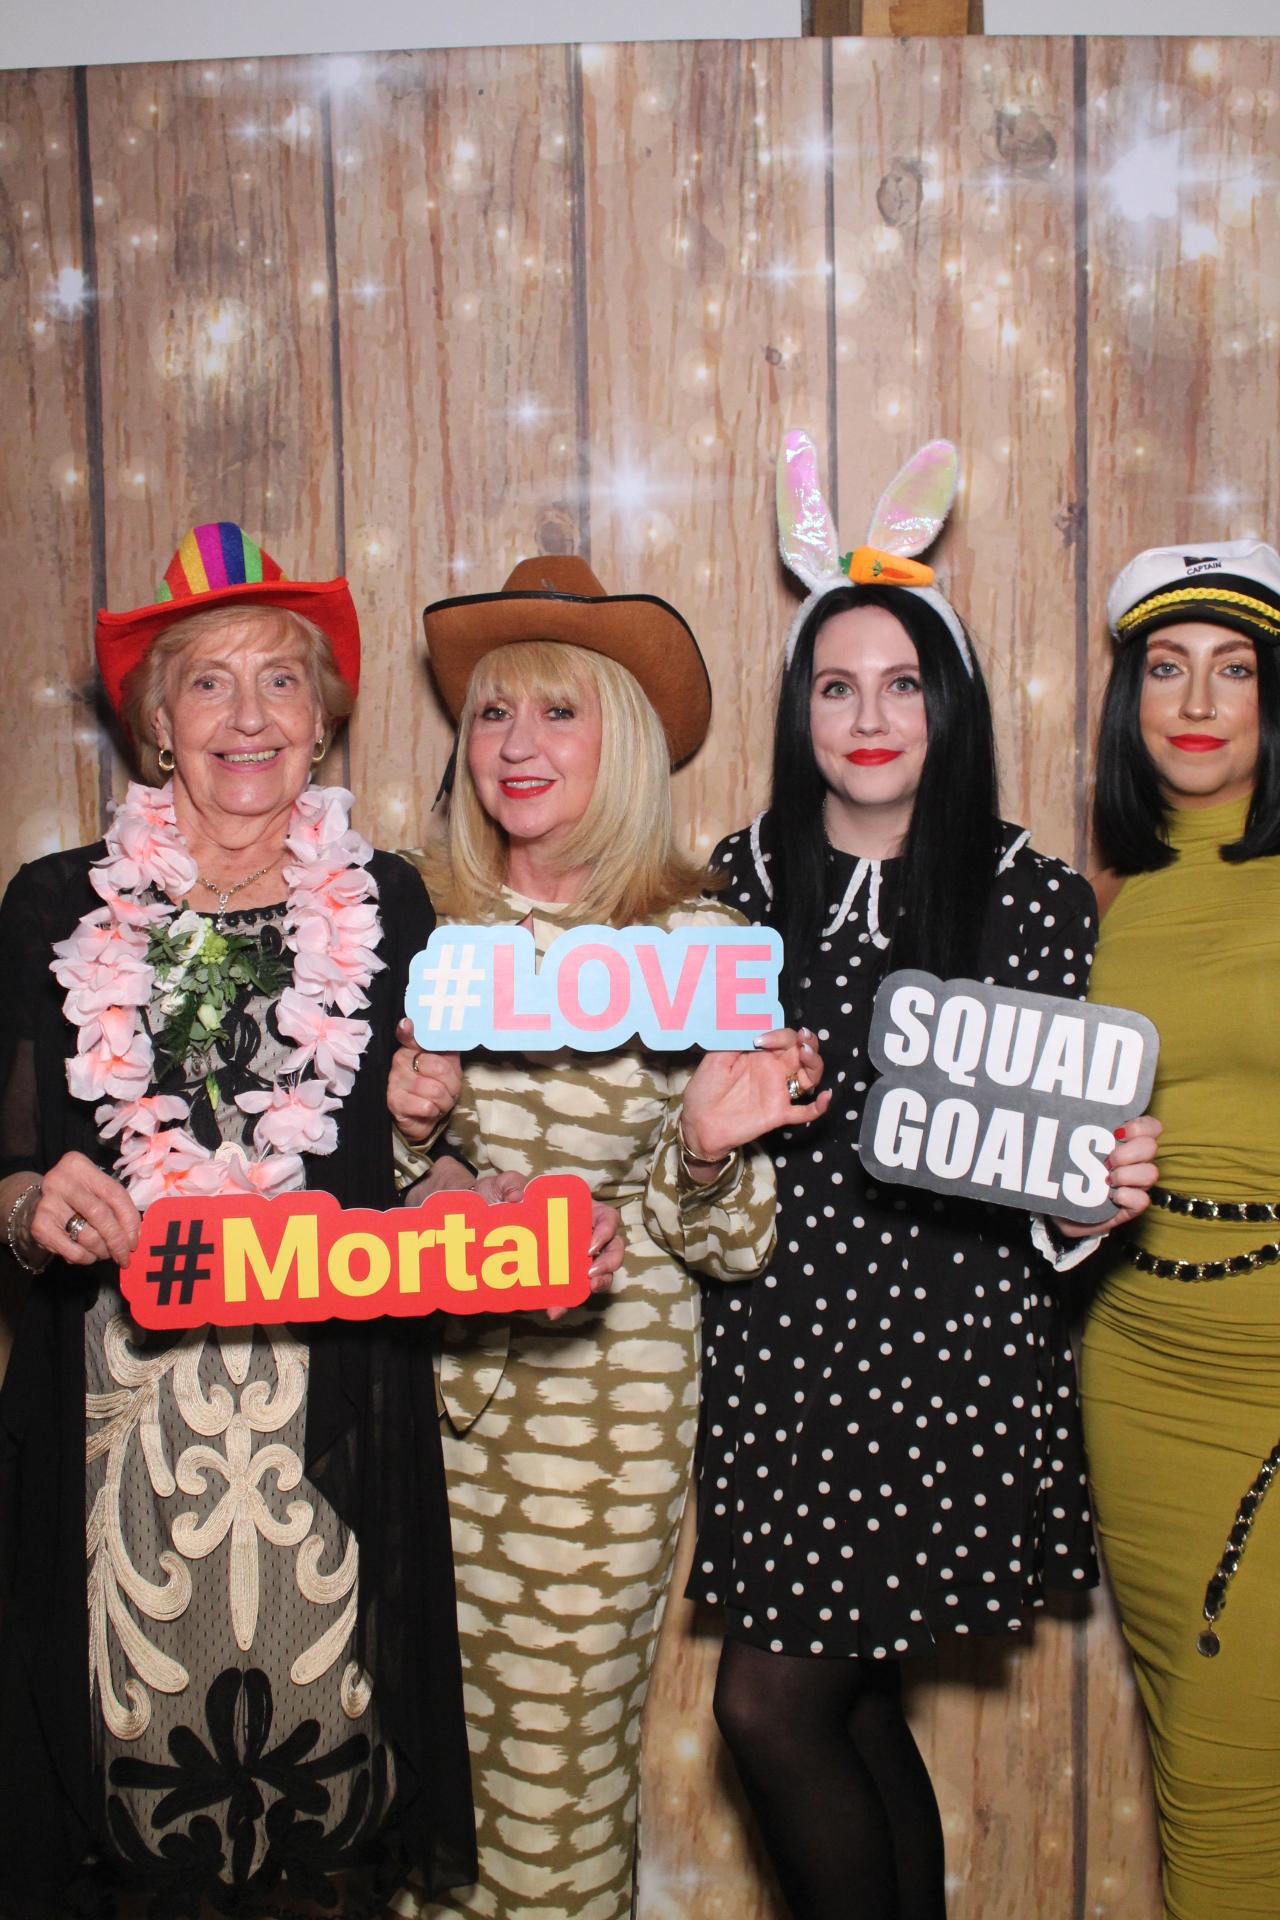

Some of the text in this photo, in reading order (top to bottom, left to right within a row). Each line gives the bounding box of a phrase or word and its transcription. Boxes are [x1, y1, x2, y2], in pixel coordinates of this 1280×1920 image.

[1187, 562, 1221, 575] CAPTAIN
[419, 944, 772, 1031] #LOVE
[884, 986, 1144, 1105] SQUAD
[874, 1088, 1116, 1208] GOALS
[146, 1197, 570, 1305] #Mortal
